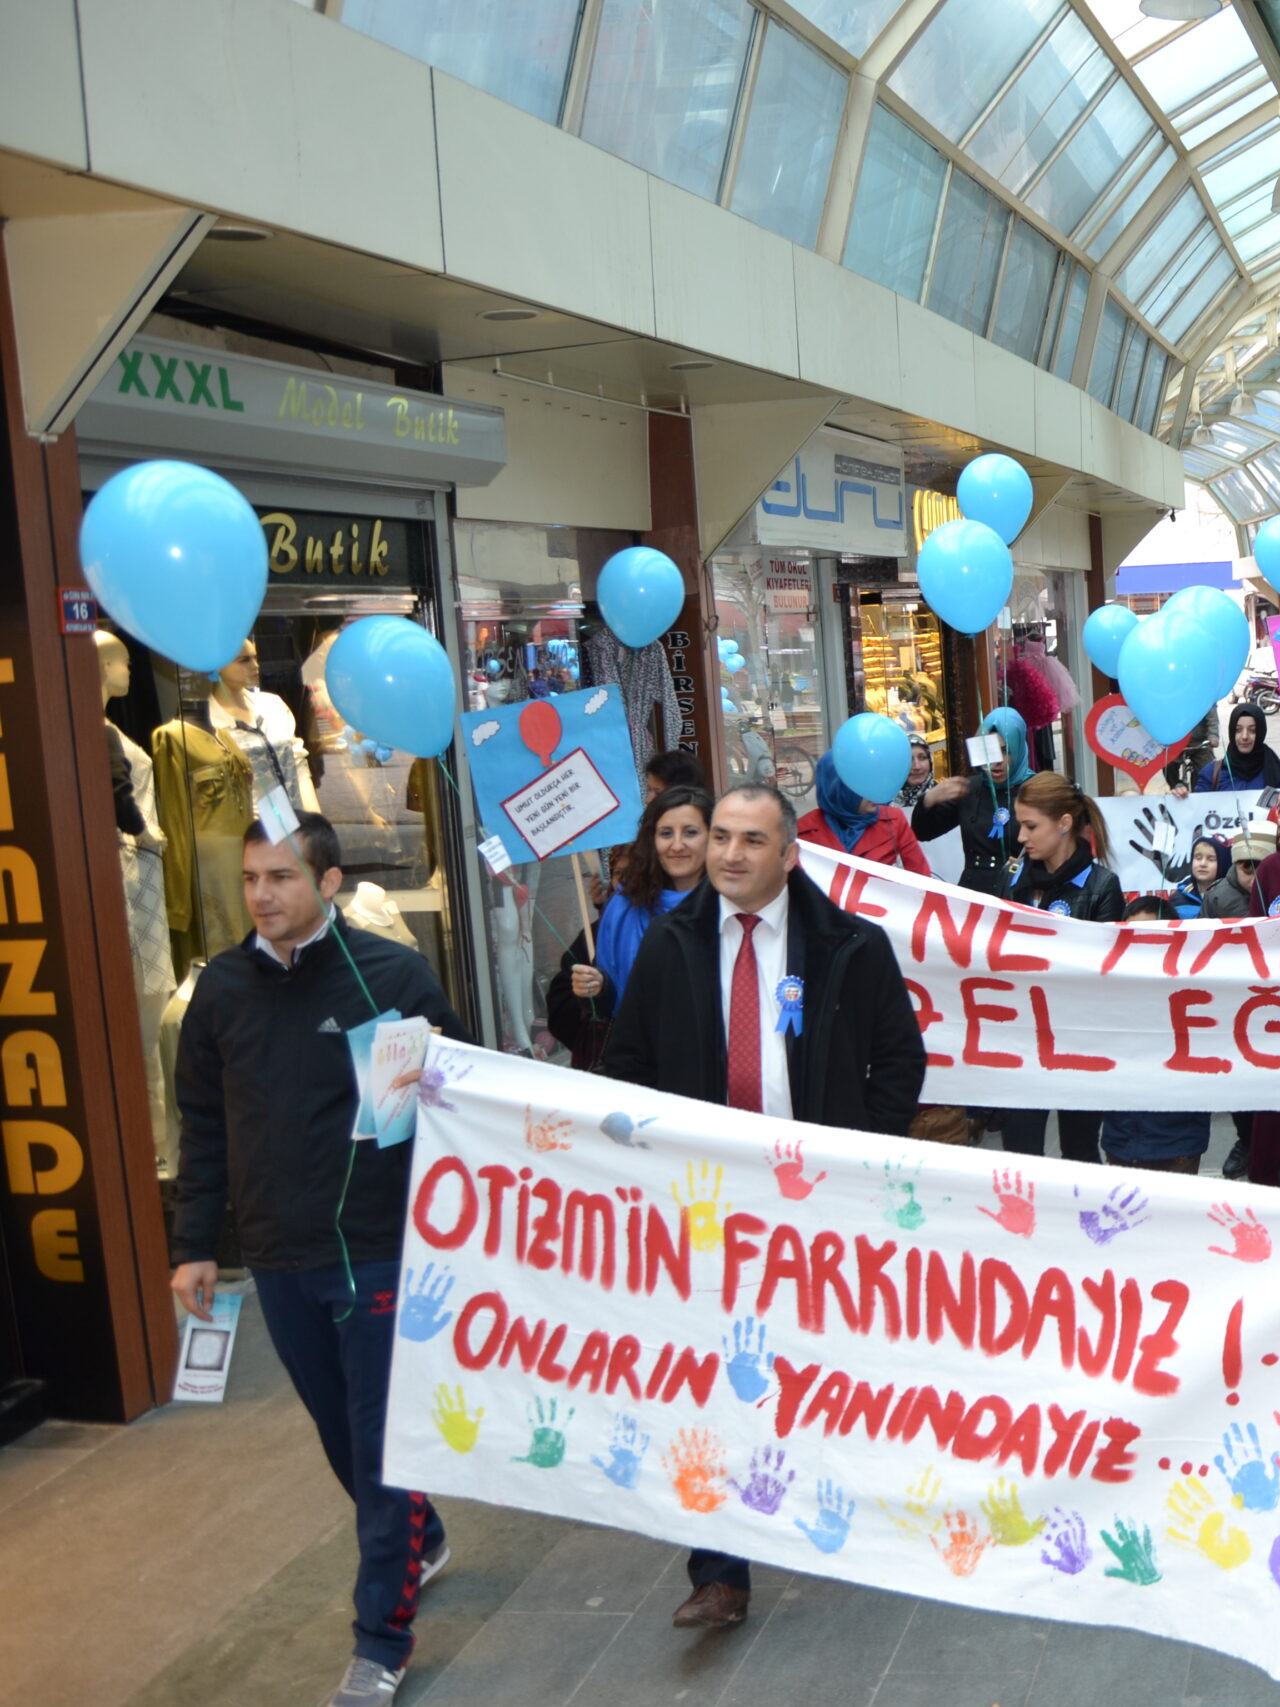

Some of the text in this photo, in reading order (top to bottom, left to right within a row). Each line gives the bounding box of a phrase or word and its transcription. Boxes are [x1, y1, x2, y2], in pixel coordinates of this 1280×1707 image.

[117, 350, 245, 413] XXXL
[277, 376, 460, 445] Model Butik
[260, 512, 389, 576] Butik
[769, 558, 785, 573] TÜM
[788, 561, 807, 575] OKUL
[72, 602, 89, 620] 16
[514, 798, 534, 814] UMUT
[560, 768, 575, 781] HER
[904, 976, 1116, 1072] ZEL
[453, 1291, 720, 1408] ONLARIN
